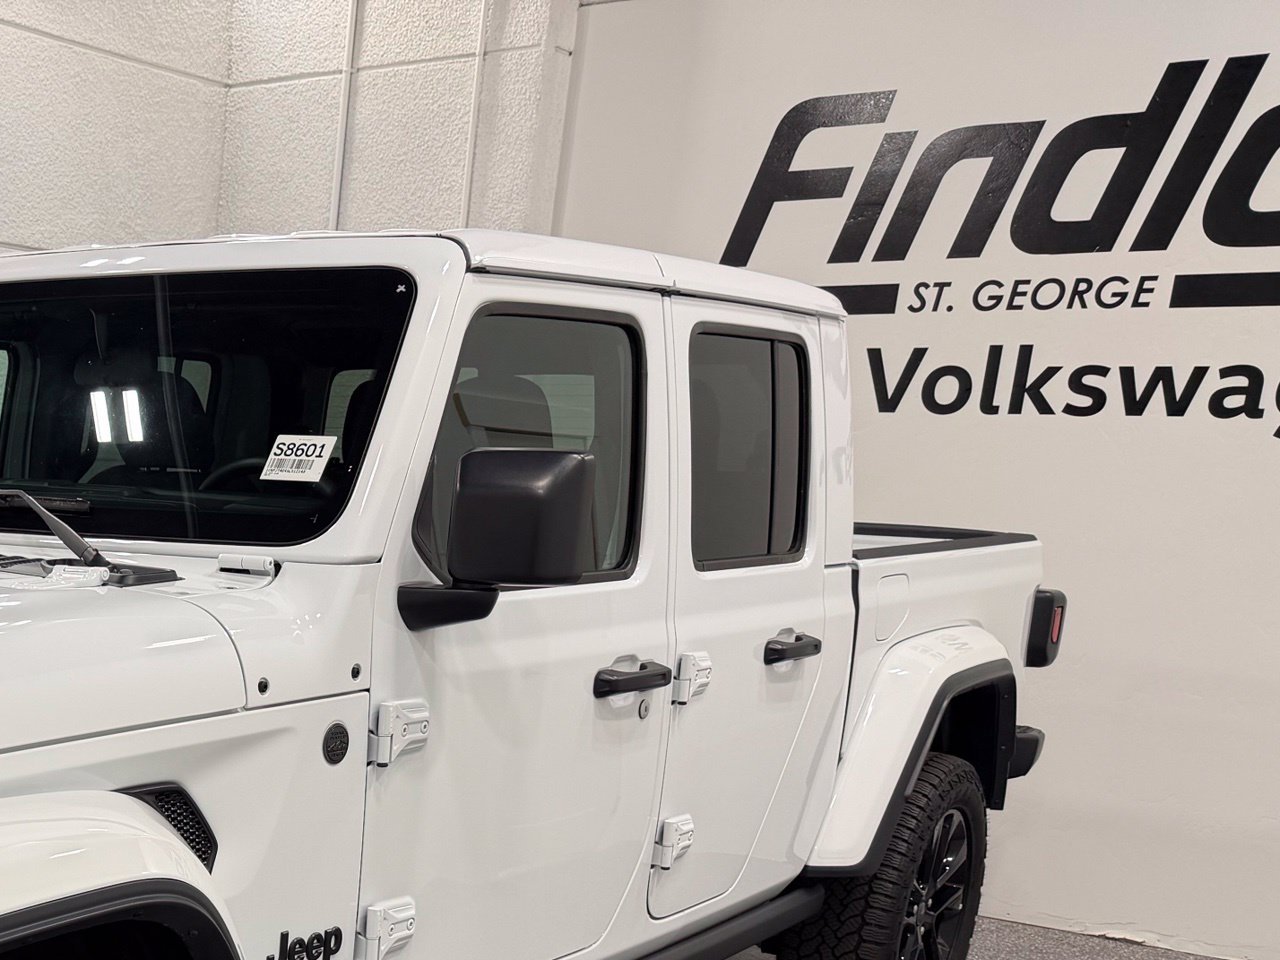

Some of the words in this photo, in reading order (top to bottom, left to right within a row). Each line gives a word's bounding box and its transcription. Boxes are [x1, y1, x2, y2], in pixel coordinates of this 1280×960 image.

[907, 281, 954, 313] ST.
[972, 275, 1159, 312] GEORGE
[866, 344, 1280, 439] Volkswa
[273, 442, 326, 459] S8601
